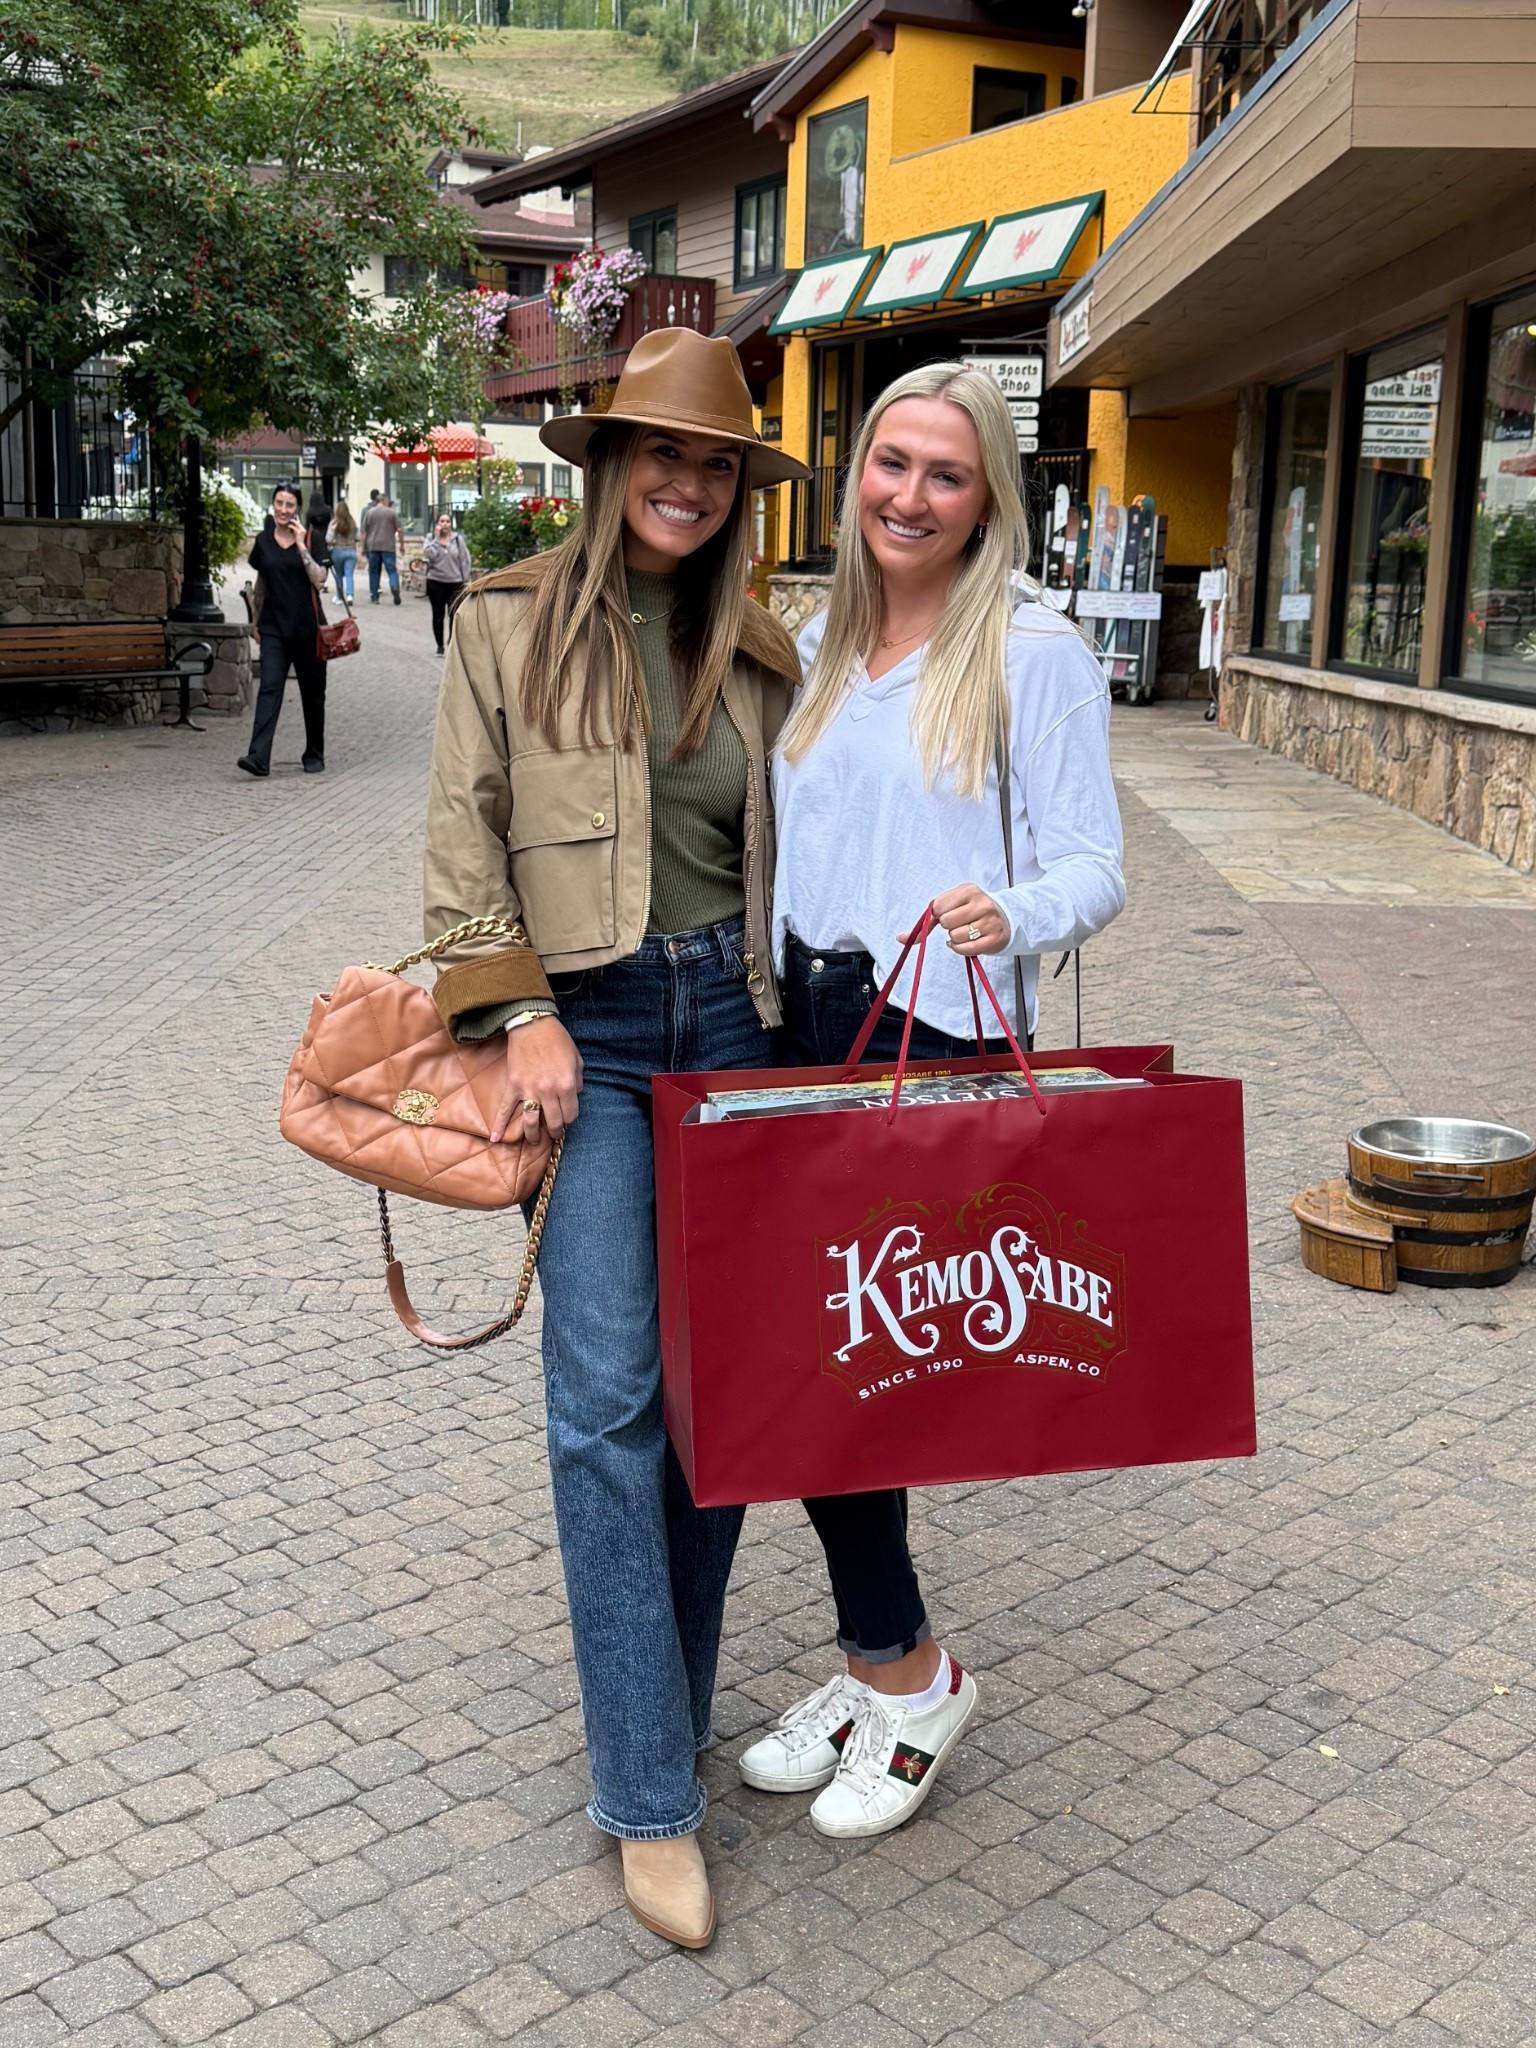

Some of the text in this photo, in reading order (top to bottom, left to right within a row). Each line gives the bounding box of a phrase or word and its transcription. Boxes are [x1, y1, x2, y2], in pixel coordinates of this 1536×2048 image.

[998, 364, 1038, 377] Sports
[1001, 379, 1030, 393] Shop
[1014, 1353, 1101, 1377] ASPEN, CO
[859, 1358, 963, 1400] SINCE 1990
